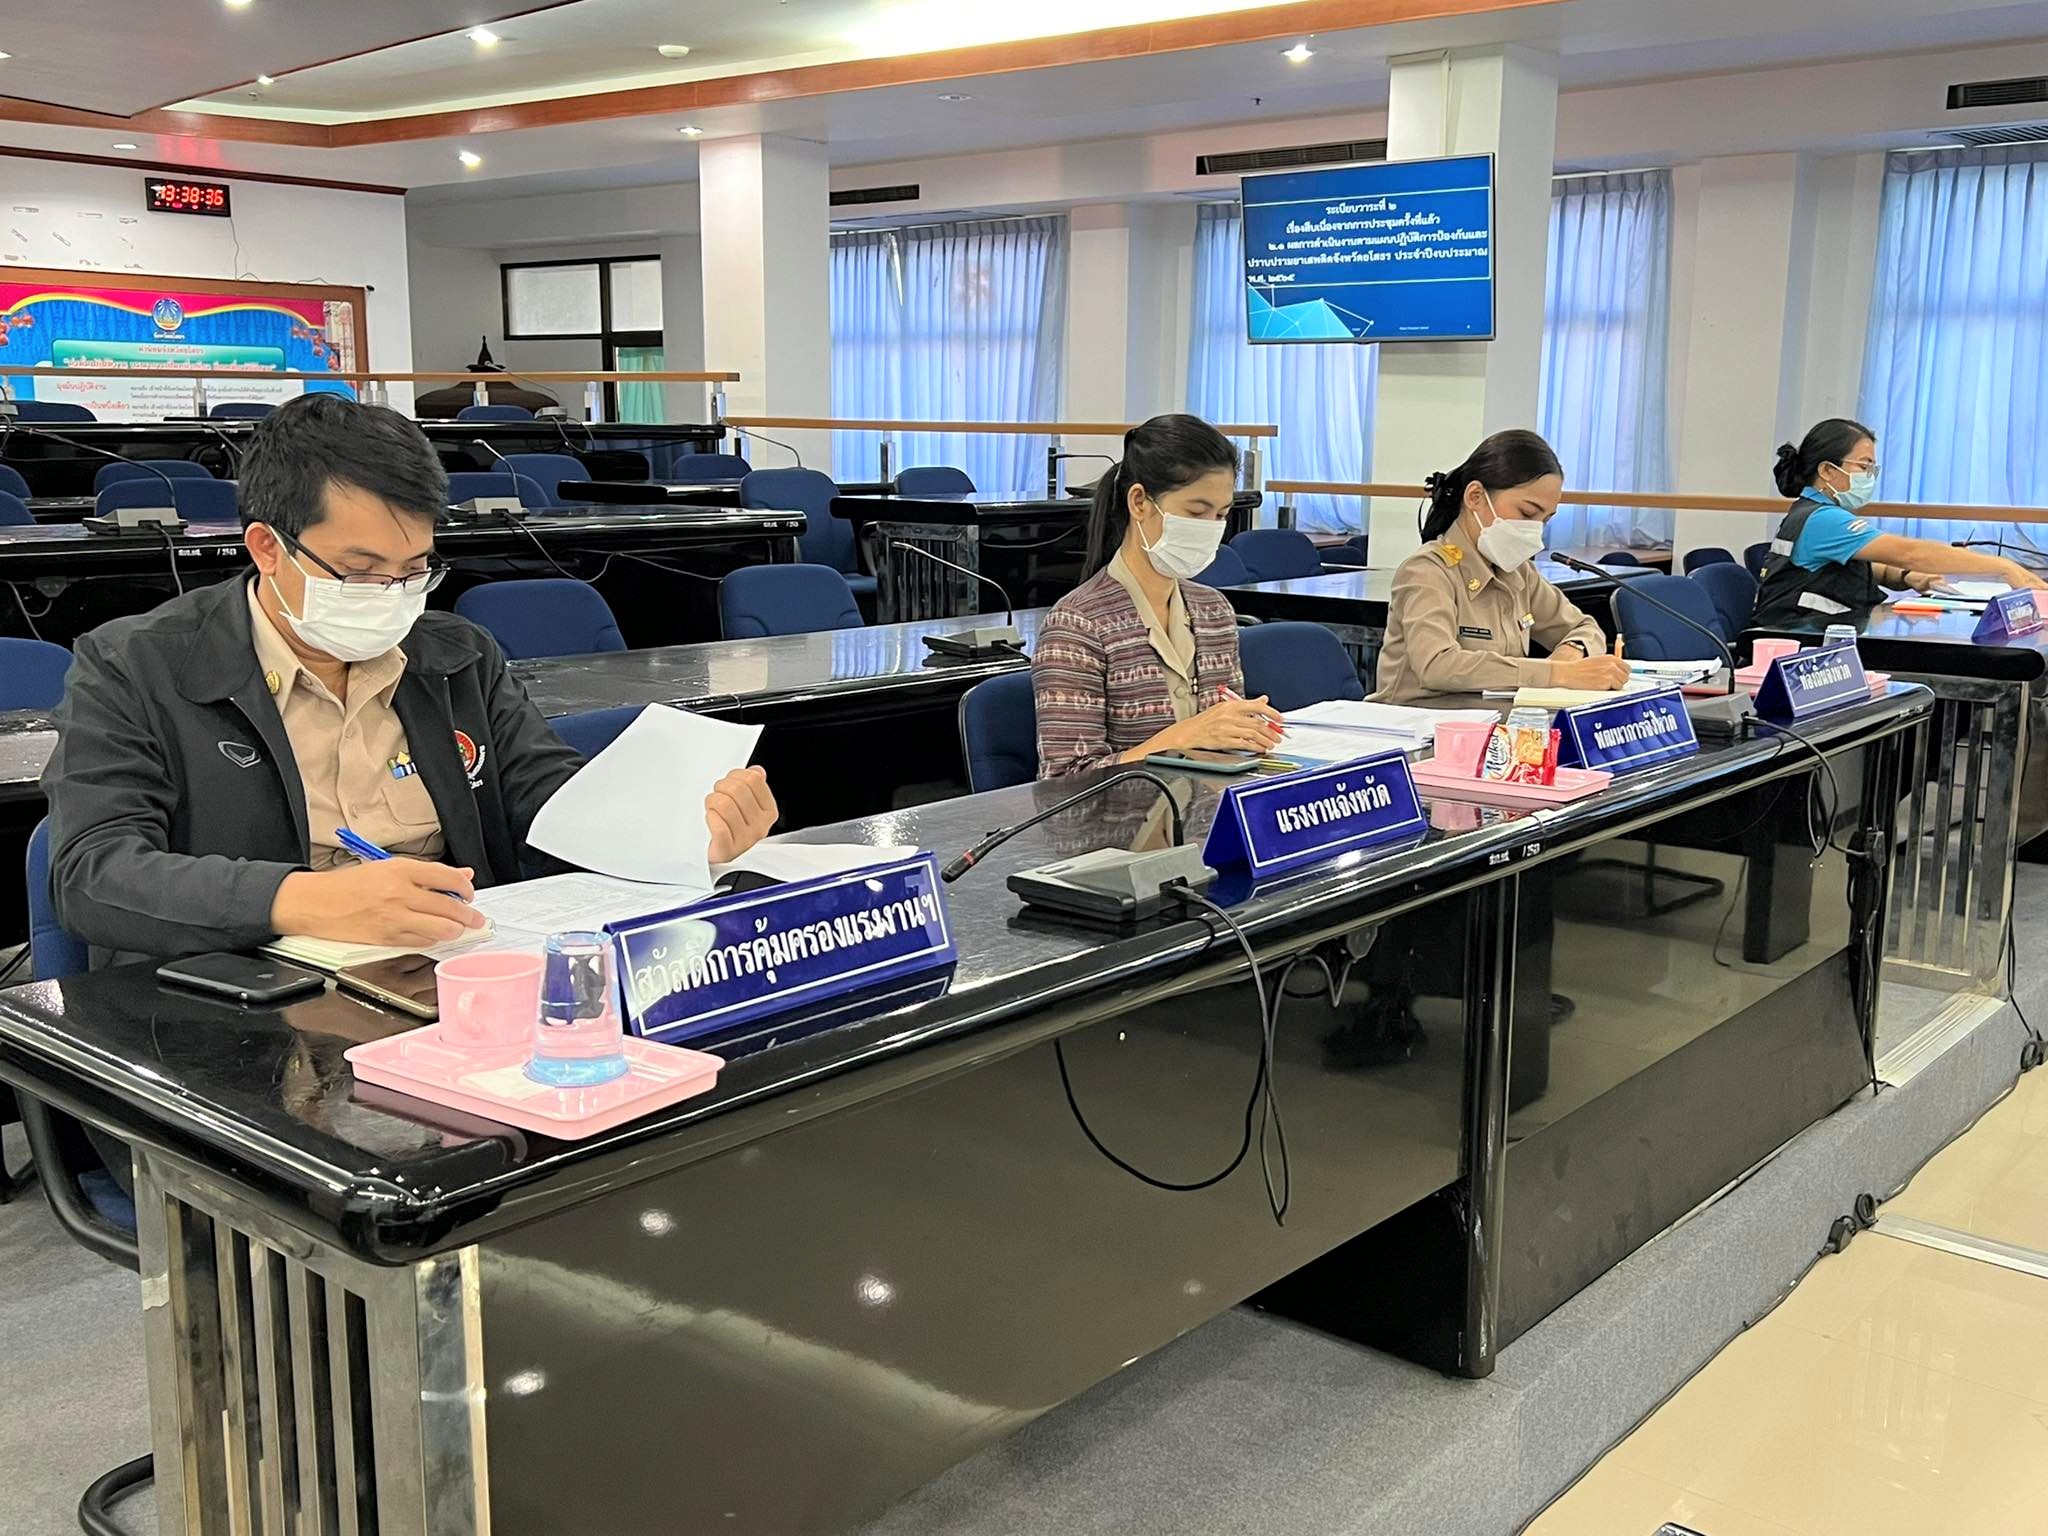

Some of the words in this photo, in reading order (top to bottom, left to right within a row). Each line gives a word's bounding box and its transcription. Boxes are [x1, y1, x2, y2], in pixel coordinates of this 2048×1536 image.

[1325, 198, 1386, 215] ระเบียบวาระที่
[1394, 247, 1488, 261] ประจำปีงบประมาณ
[1594, 707, 1678, 750] พัฒนาการจังหวัด
[1276, 776, 1392, 834] แรงงานจังหวัด
[634, 892, 938, 1002] สวัสดิการคุ้มครองแรงงานฯ
